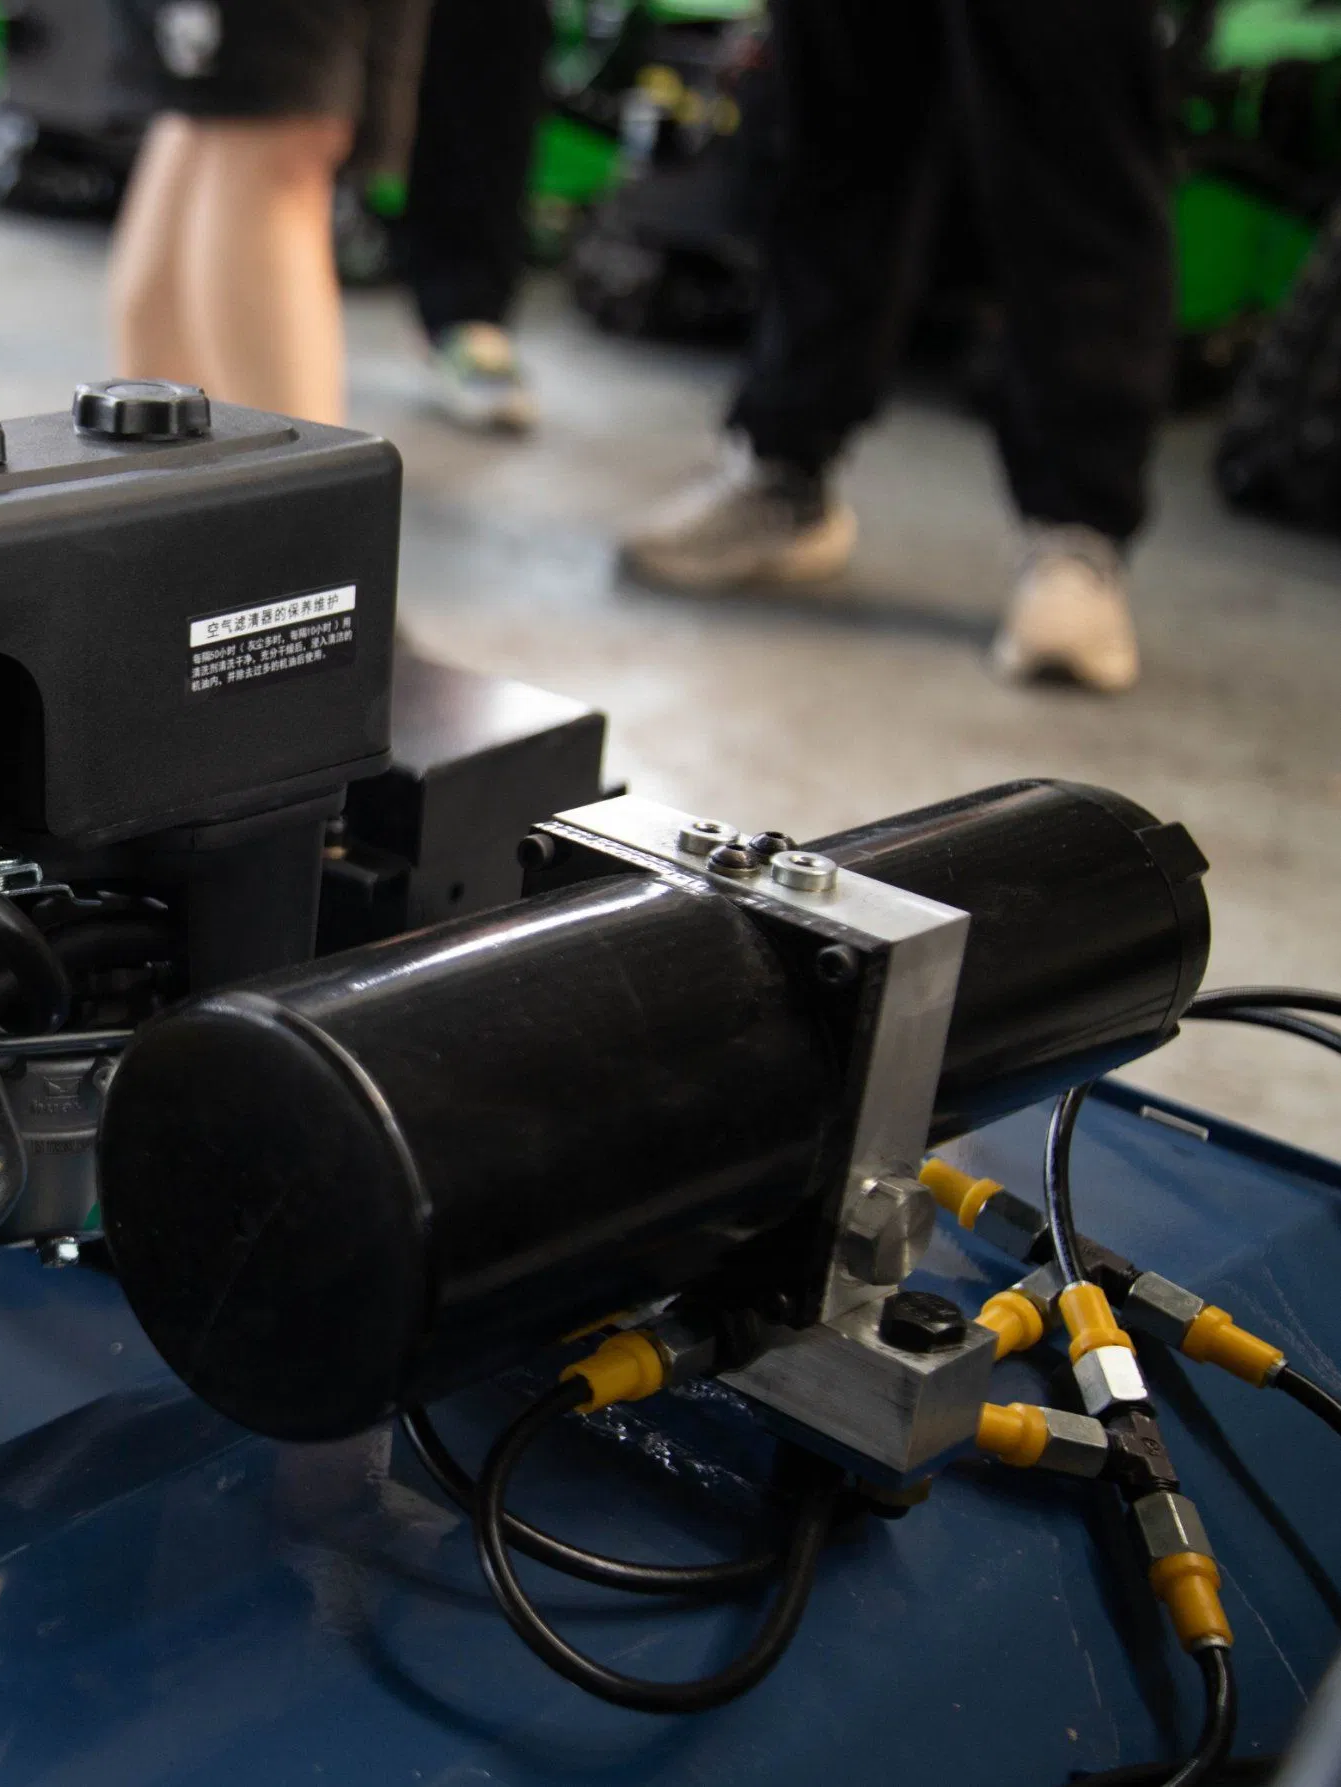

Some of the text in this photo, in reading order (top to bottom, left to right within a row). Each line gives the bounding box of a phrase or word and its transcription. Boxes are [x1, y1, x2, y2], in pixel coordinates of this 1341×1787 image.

[206, 594, 339, 639] 空气滤清器的保养维护
